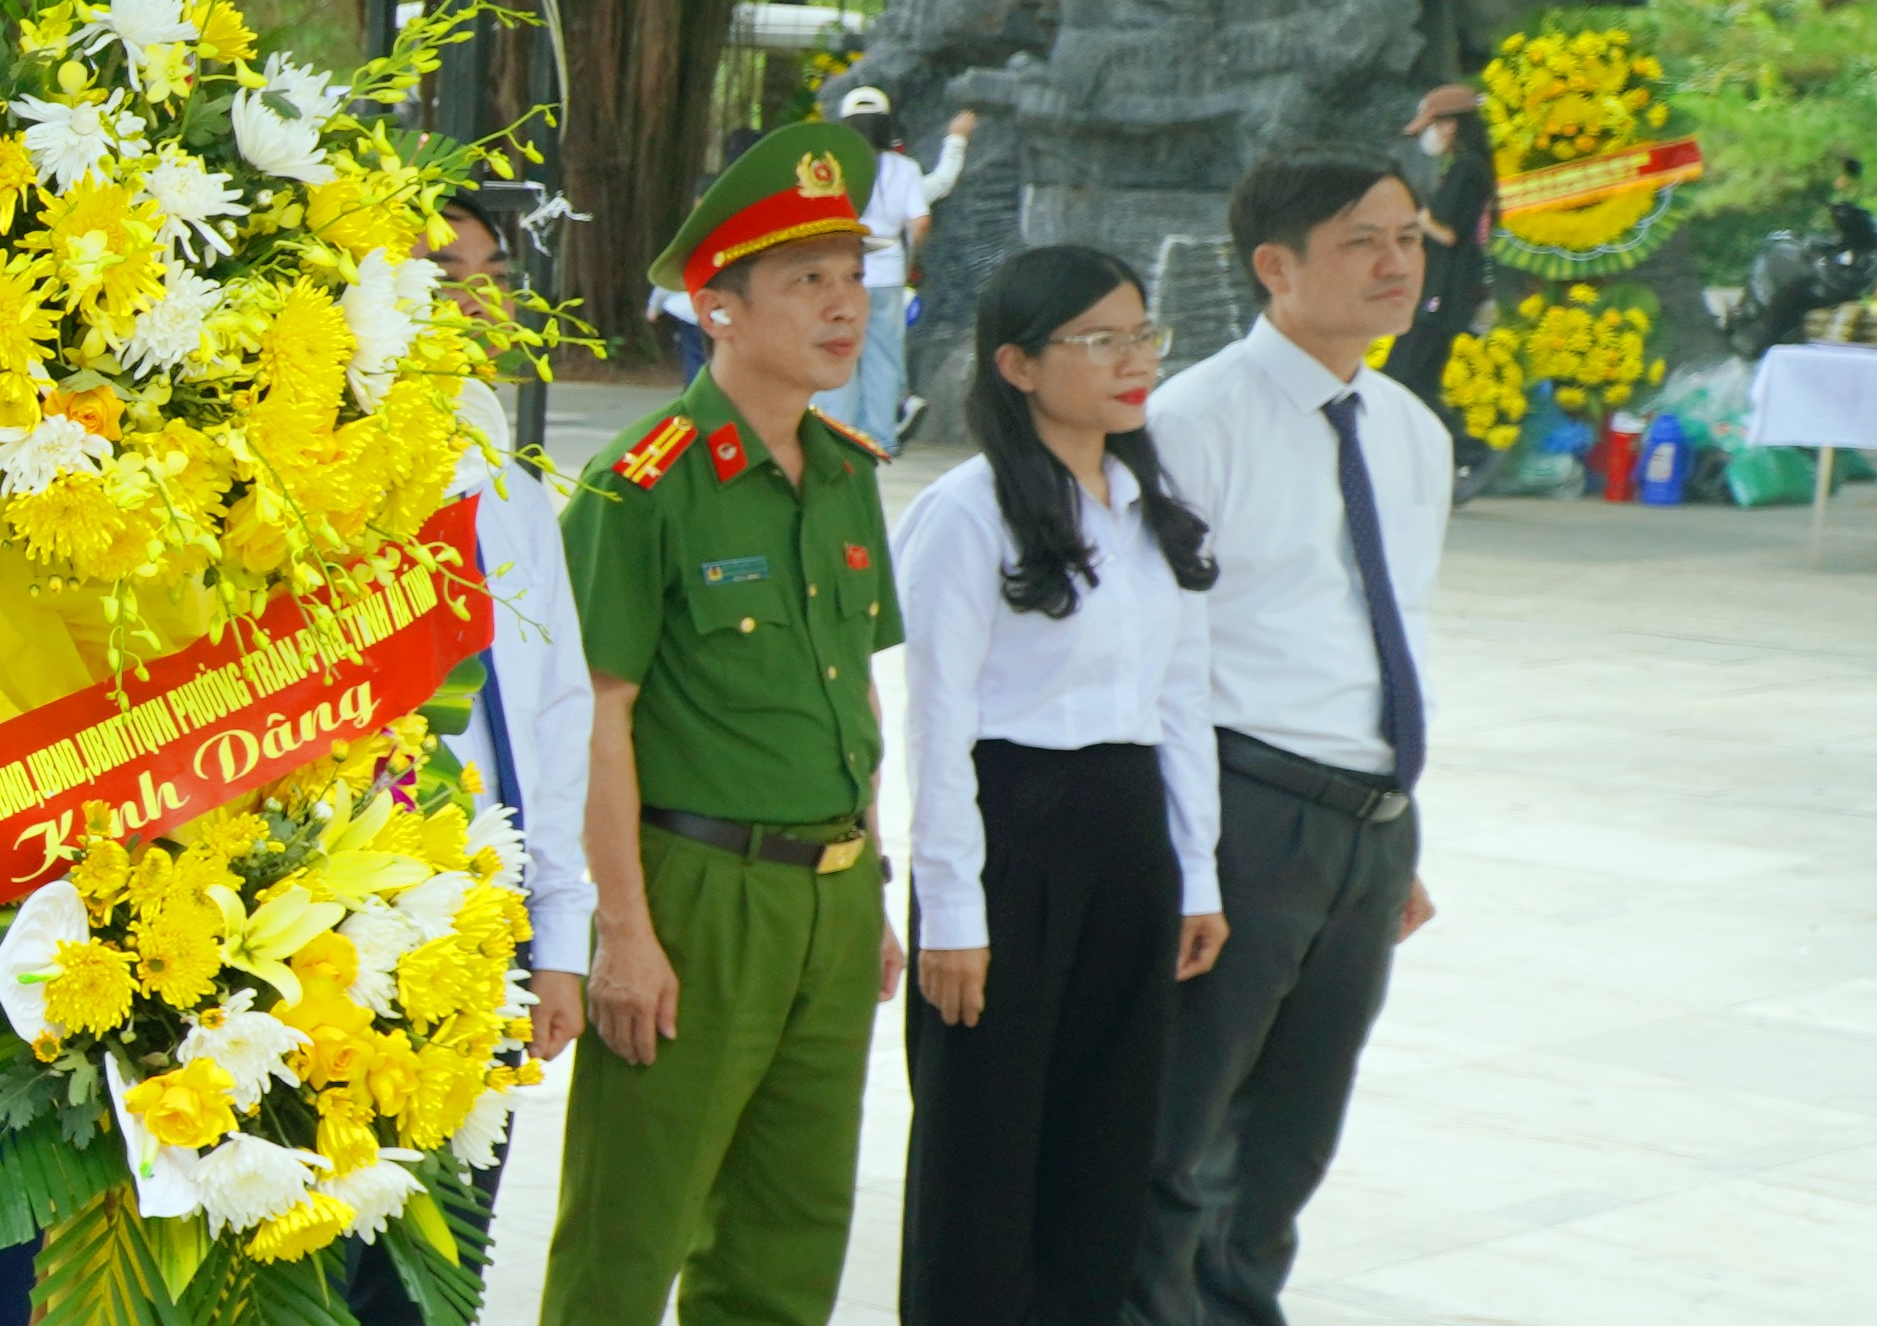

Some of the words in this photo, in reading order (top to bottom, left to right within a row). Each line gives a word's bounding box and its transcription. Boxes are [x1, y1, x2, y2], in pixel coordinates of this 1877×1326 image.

[165, 662, 254, 735] PHƯỜNG
[10, 769, 191, 883] Knh
[193, 680, 382, 784] Dâng
